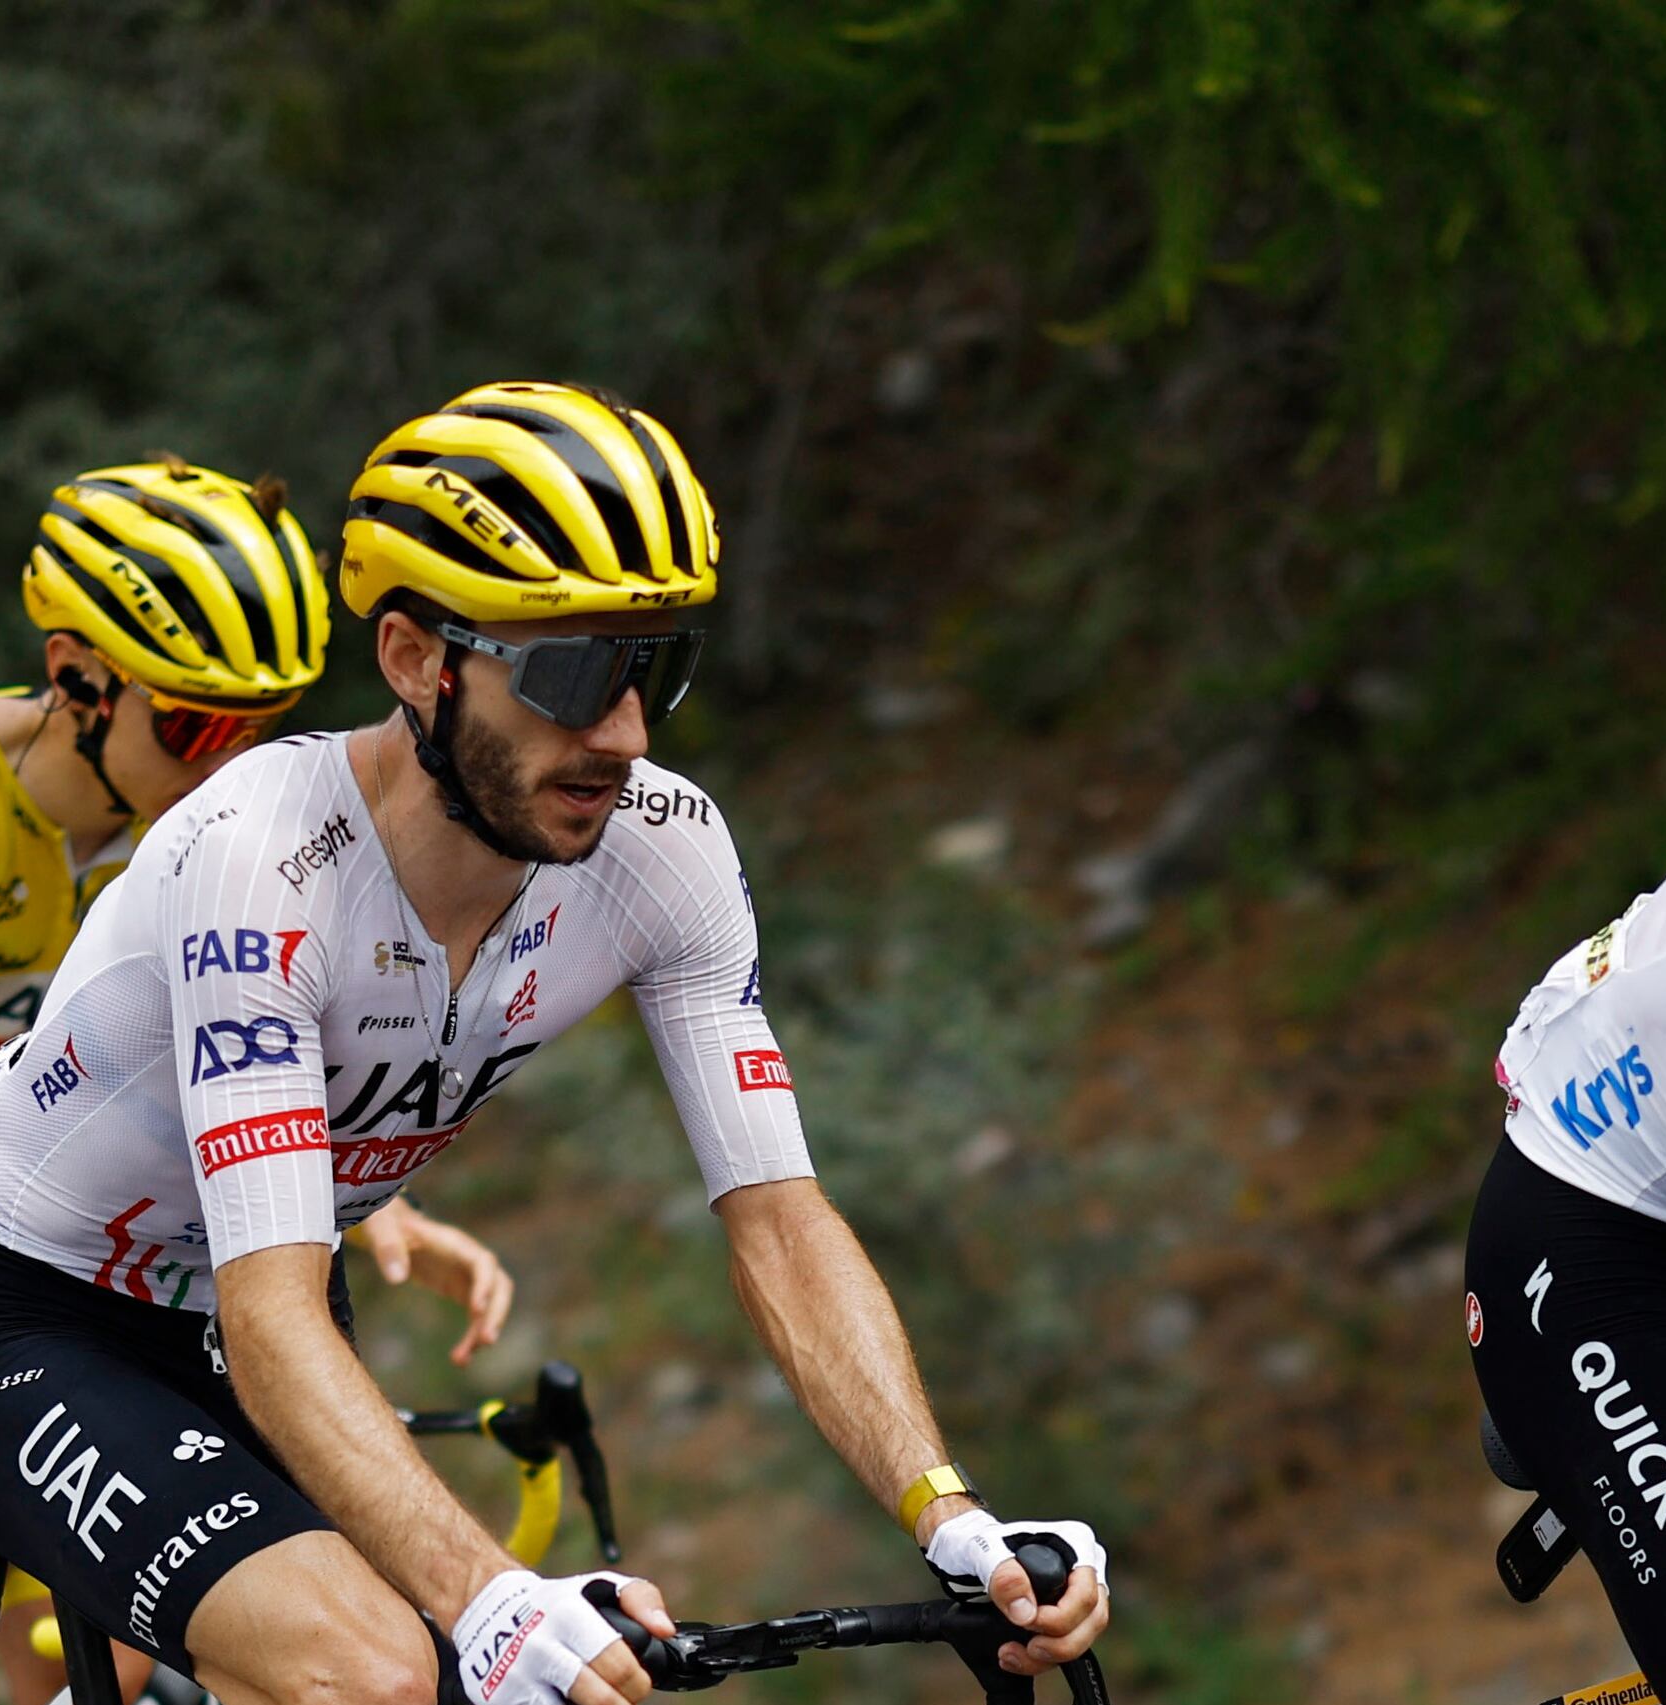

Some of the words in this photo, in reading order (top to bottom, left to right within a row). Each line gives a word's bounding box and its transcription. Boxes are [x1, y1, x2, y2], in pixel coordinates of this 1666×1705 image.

[424, 471, 534, 550] MET
[109, 560, 191, 646] MET
[615, 783, 712, 827] sight
[183, 929, 271, 984] FAB
[510, 920, 547, 964] FAB
[191, 1016, 302, 1086] ADQ
[368, 1016, 416, 1031] PISSEI
[31, 1054, 81, 1112] FAB
[1550, 1045, 1656, 1152] Krys
[197, 1115, 329, 1176] Emirates
[18, 1402, 147, 1562] UAE
[1592, 1475, 1656, 1587] FLOORS
[129, 1490, 261, 1649] Emirates
[471, 1600, 534, 1681] UAE
